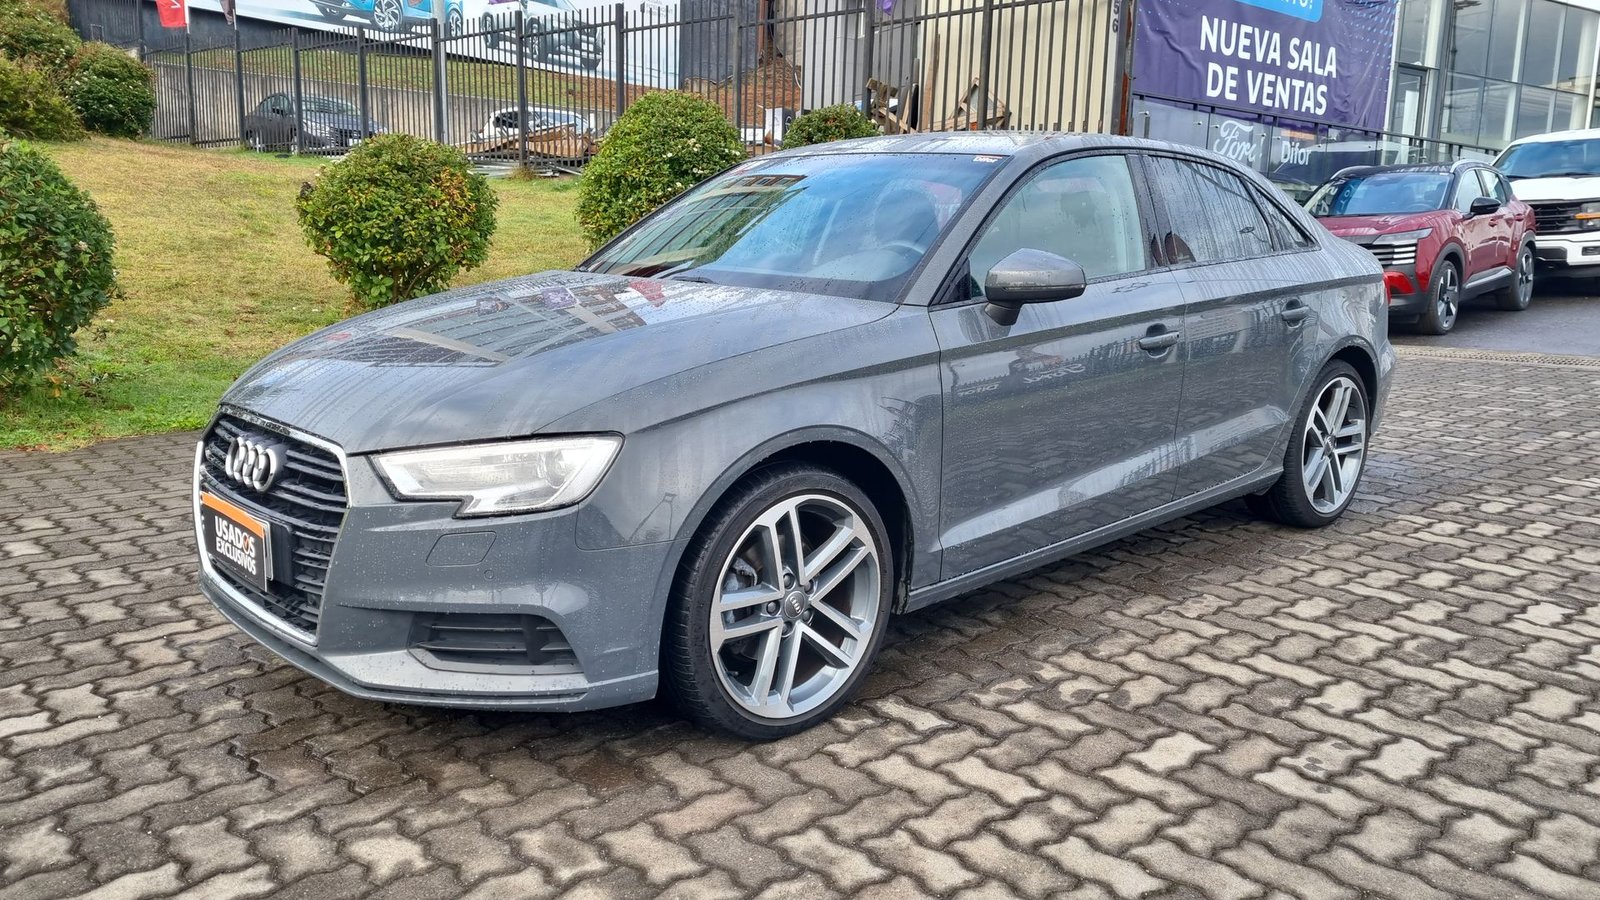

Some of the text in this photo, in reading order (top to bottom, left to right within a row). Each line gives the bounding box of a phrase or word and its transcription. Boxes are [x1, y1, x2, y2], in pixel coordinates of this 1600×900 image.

[1200, 15, 1337, 79] NUEVA SALA
[1206, 62, 1328, 116] DE VENTAS
[1213, 120, 1265, 163] Ford
[1280, 140, 1312, 166] Difor
[214, 515, 256, 558] USADOS
[215, 536, 257, 575] EXCLUSIVOS
